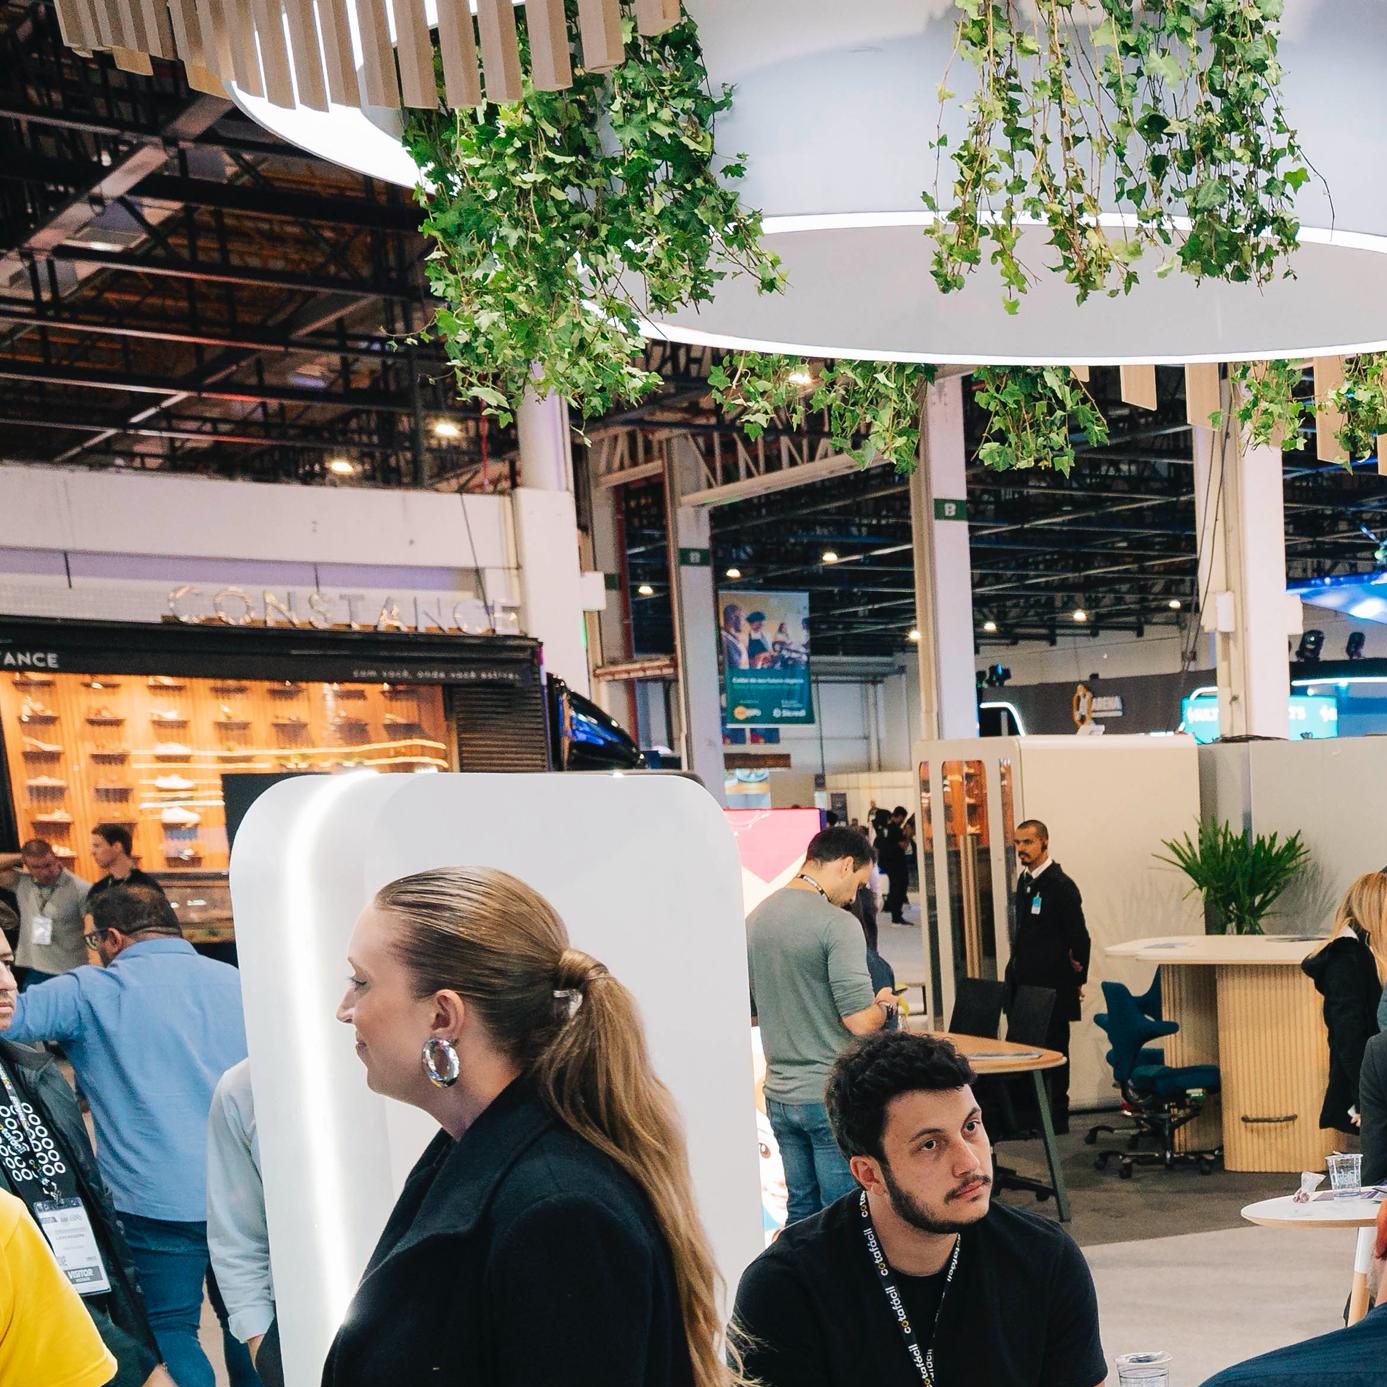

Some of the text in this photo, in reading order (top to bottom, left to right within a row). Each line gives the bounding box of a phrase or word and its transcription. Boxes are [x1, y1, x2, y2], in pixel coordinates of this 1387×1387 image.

[943, 503, 957, 518] B
[168, 585, 521, 636] CONSTANCE
[0, 651, 59, 669] ANCE
[863, 1227, 889, 1277] cotafácil
[68, 1269, 93, 1280] VISITOR
[884, 1285, 912, 1335] cotafácil
